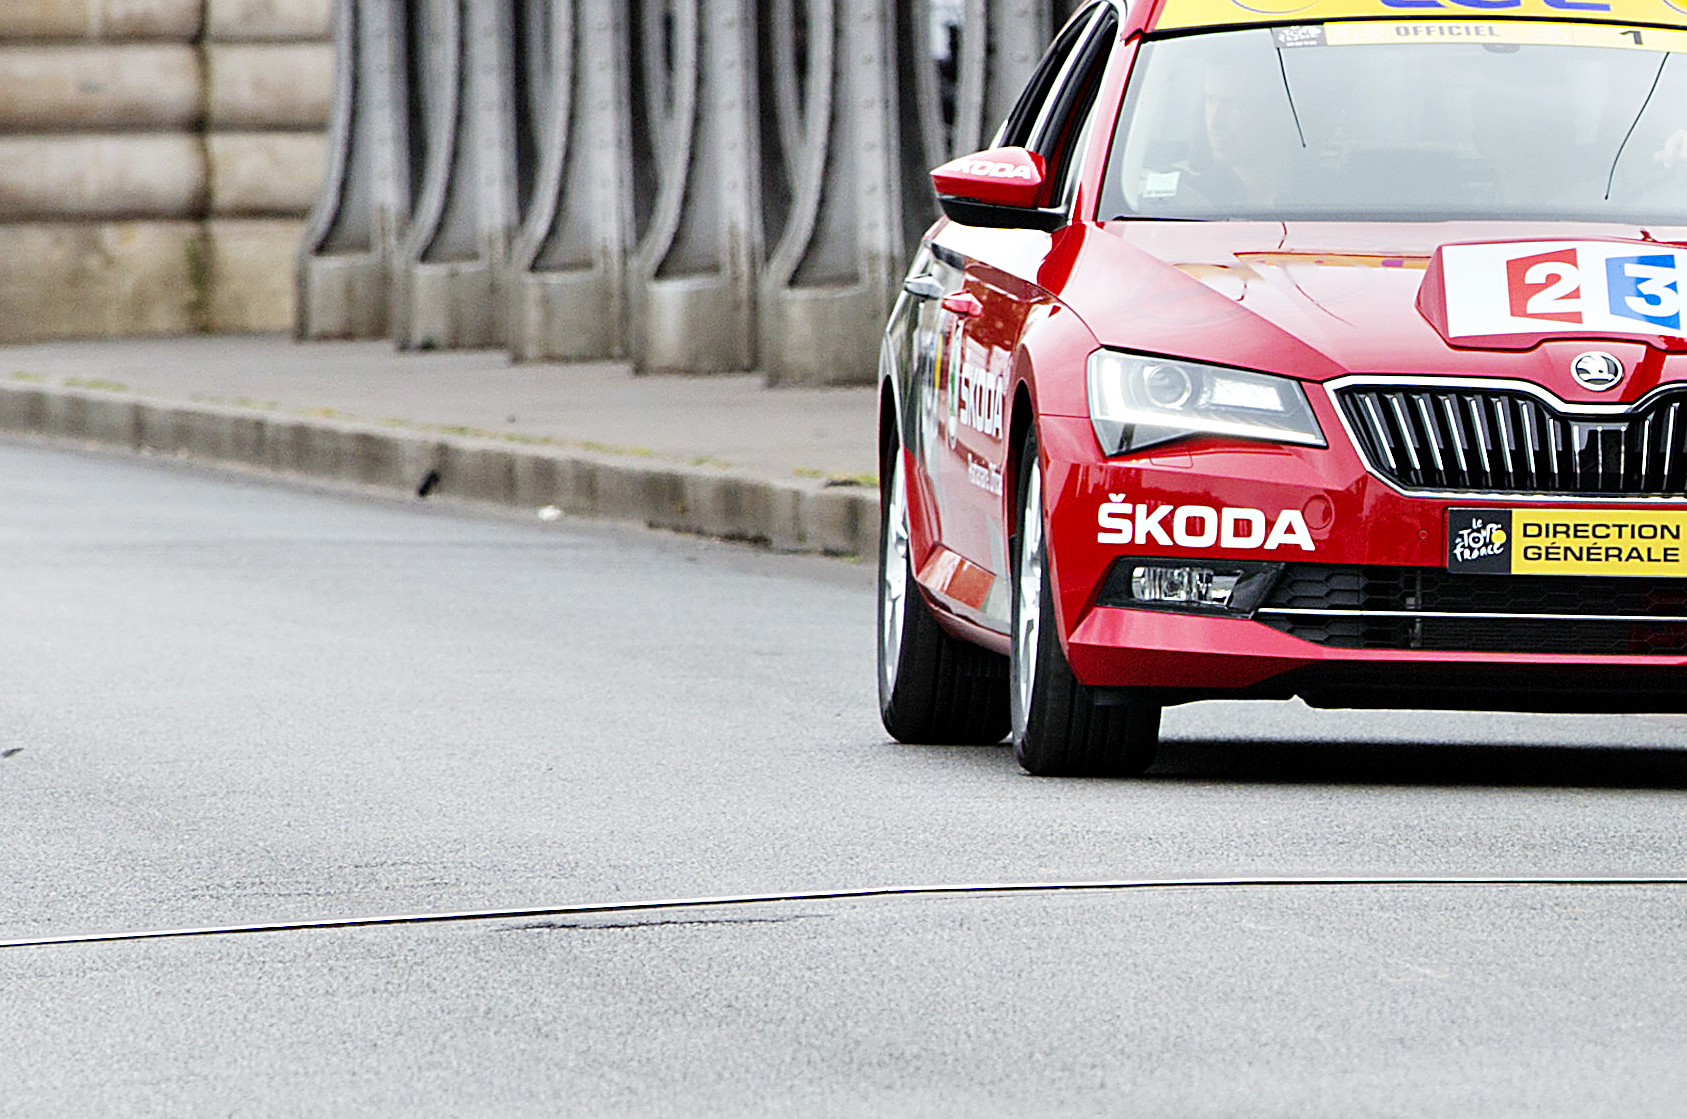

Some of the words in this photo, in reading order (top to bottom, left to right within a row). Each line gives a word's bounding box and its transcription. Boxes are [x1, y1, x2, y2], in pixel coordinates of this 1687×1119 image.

[1395, 25, 1501, 37] OFFICIEL
[1620, 30, 1643, 46] 1
[1524, 261, 1582, 315] 2
[1624, 263, 1681, 318] 3
[1097, 493, 1316, 552] ŠKODA
[1522, 522, 1681, 540] DIRECTION
[1523, 541, 1680, 563] GÉNÉRALE
